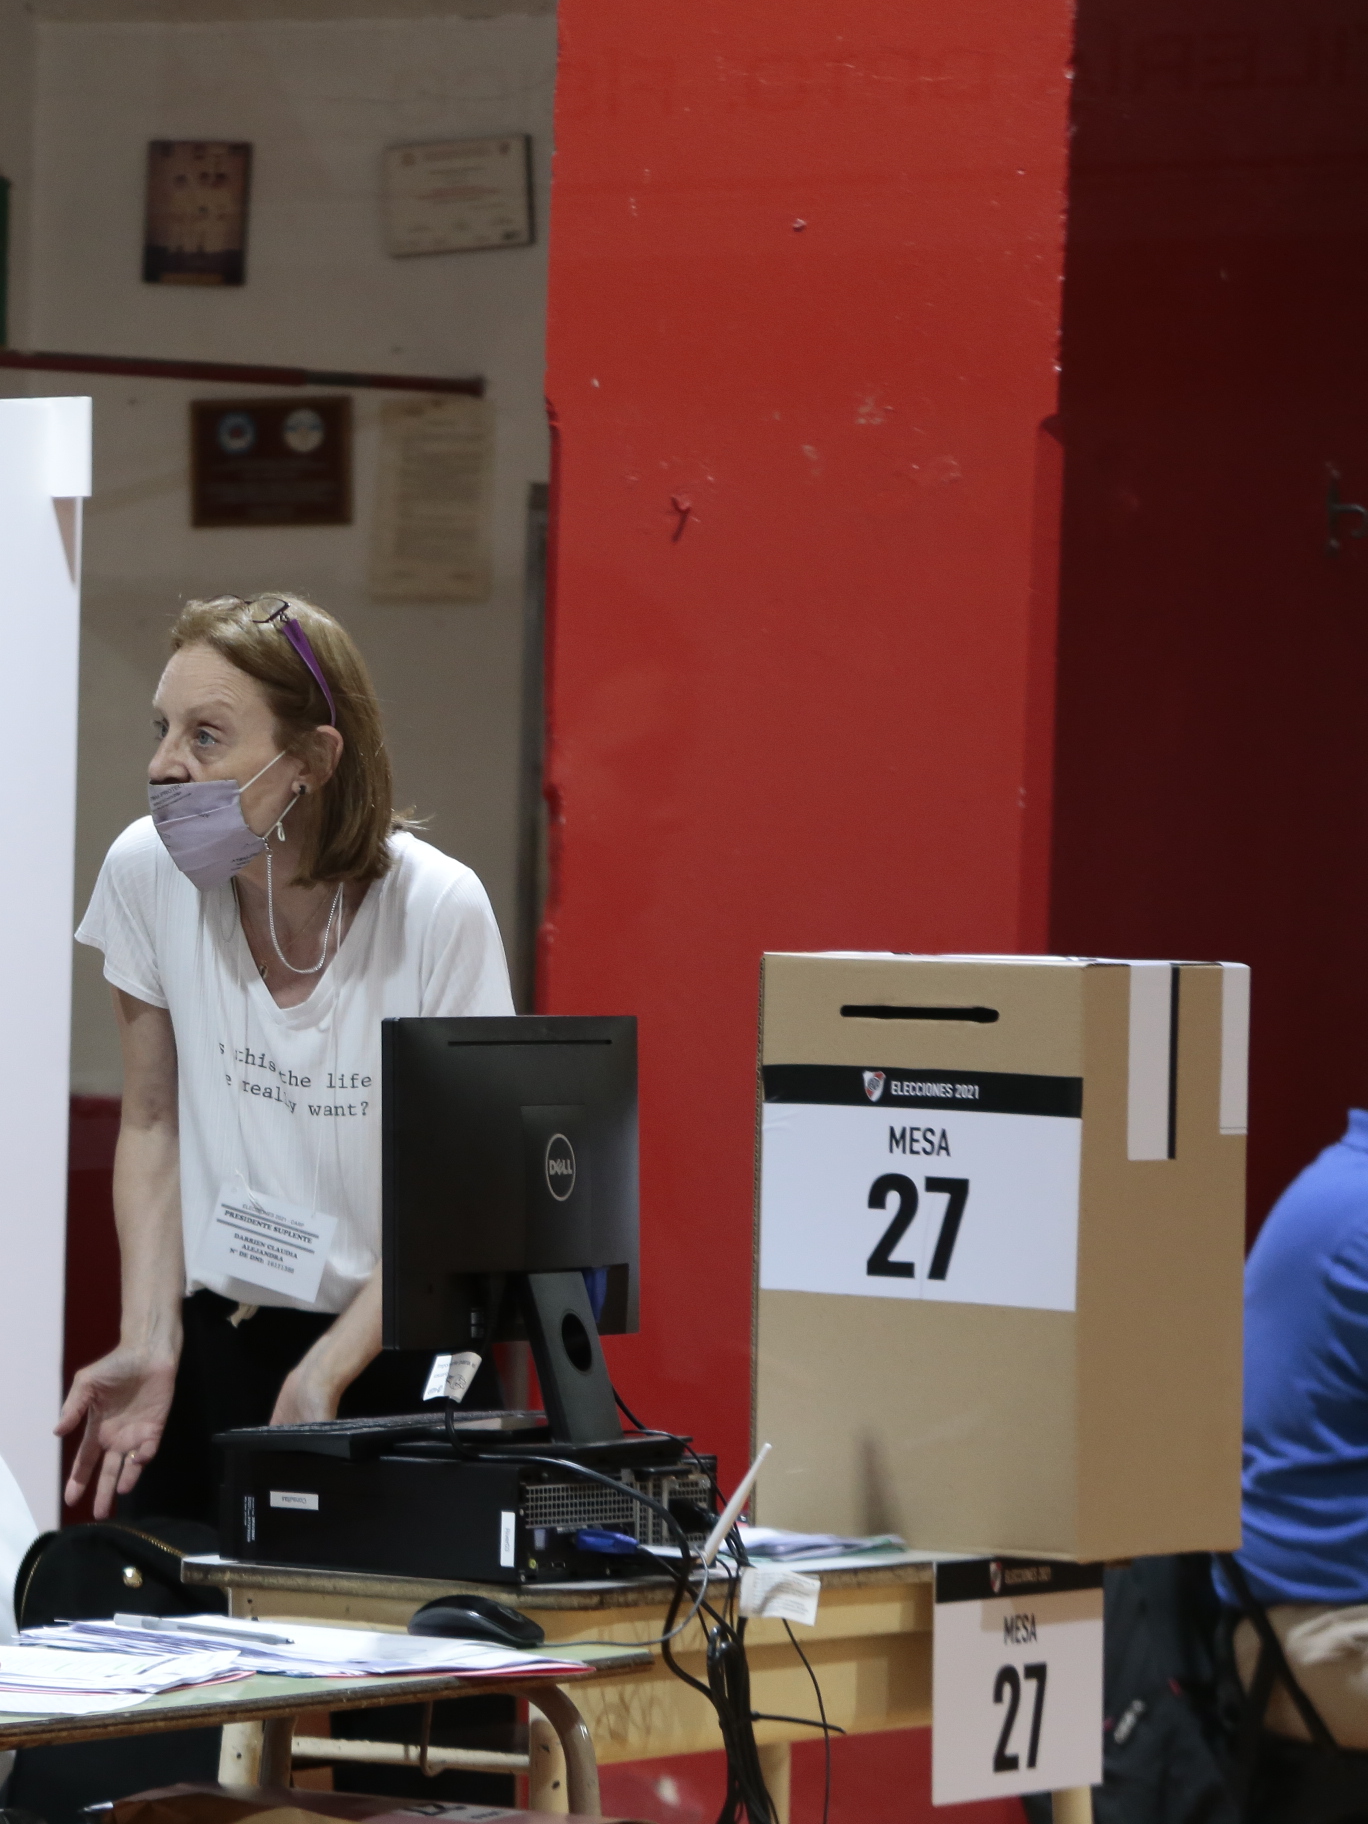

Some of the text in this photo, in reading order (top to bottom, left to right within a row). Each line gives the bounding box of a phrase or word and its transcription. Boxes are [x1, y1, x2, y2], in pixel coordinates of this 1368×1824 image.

[279, 1070, 311, 1088] the
[326, 1073, 372, 1089] life
[890, 1080, 980, 1099] ELECCIONES 2021
[242, 1080, 297, 1114] really
[308, 1101, 369, 1116] want?
[888, 1125, 951, 1157] MESA
[549, 1159, 572, 1175] DELL
[242, 1203, 274, 1218] ELECCIONES
[224, 1209, 313, 1244] PRESIDENTE SUPLENTE
[866, 1172, 970, 1281] 27
[241, 1243, 283, 1262] ALEJANDRA
[267, 1244, 298, 1259] CLAUDIA
[1003, 1613, 1037, 1645] MESA
[993, 1662, 1047, 1774] 27
